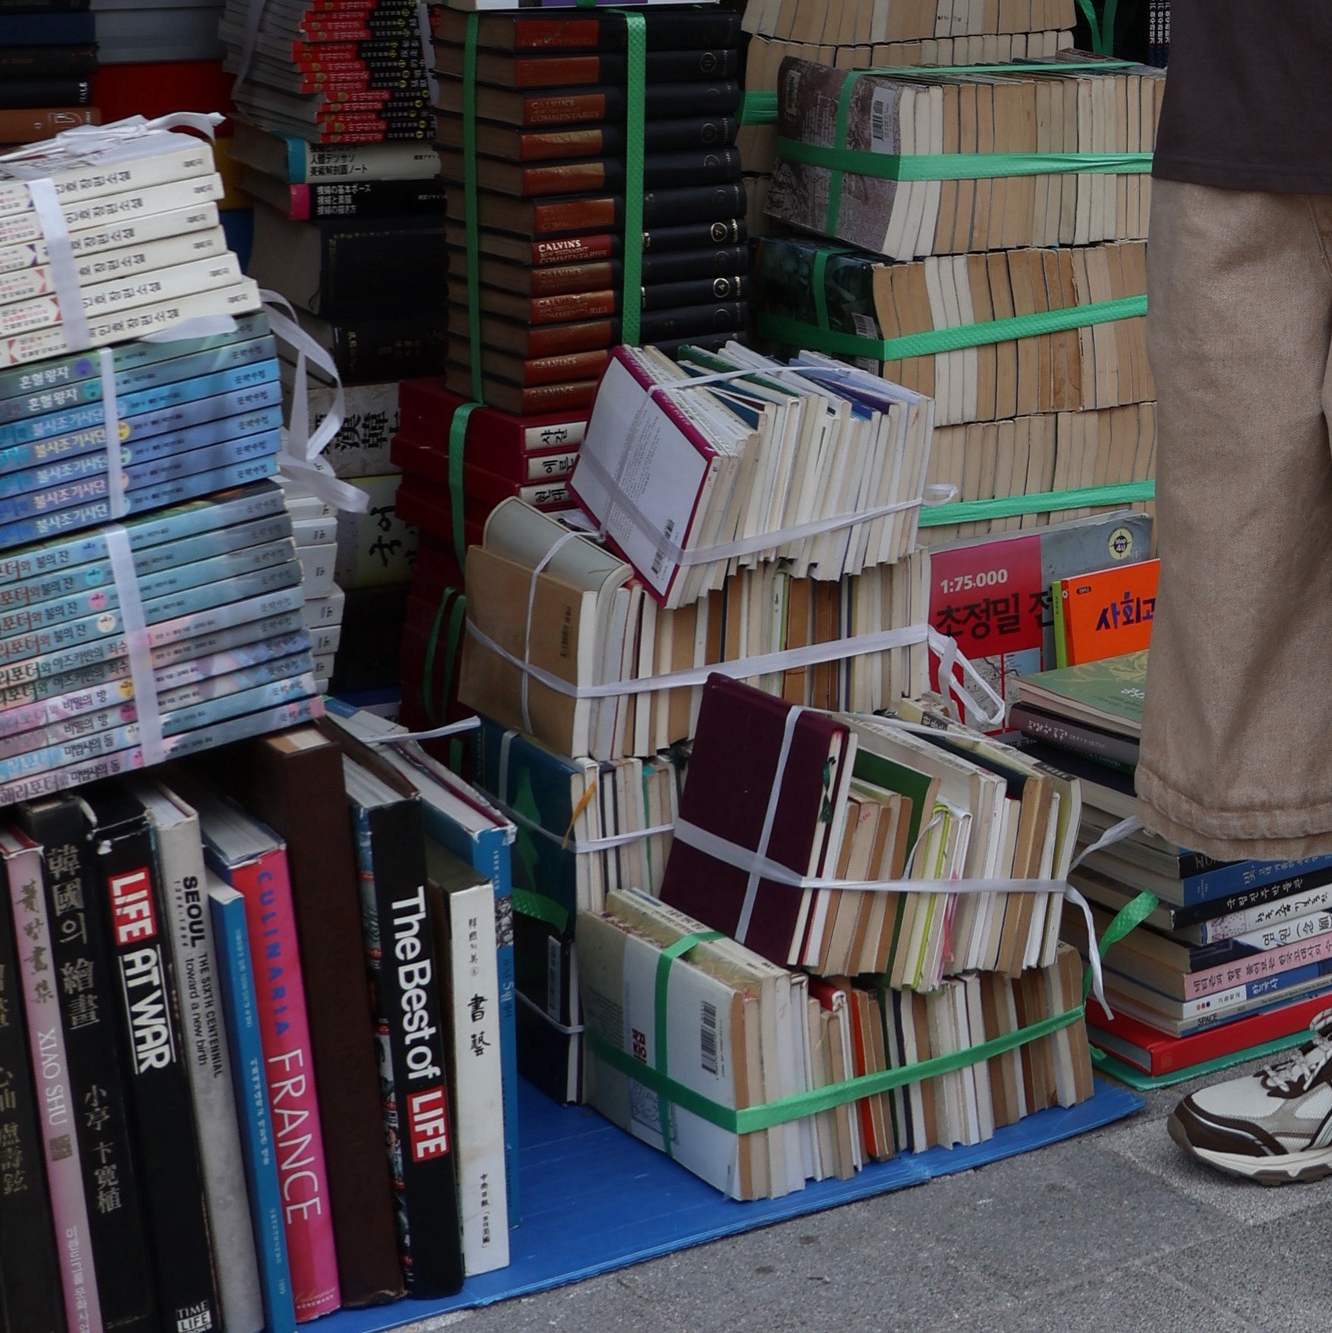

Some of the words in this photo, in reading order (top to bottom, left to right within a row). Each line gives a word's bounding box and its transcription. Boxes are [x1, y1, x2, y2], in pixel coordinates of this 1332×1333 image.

[538, 239, 582, 253] CALVIN'S
[940, 569, 1008, 594] 1:75,000
[936, 593, 1021, 640] 초정밀
[111, 871, 155, 943] LIFE
[183, 876, 205, 947] SEOUL
[391, 885, 427, 961] The
[123, 947, 161, 988] AT
[199, 953, 209, 974] THE
[256, 871, 291, 1037] CULINARIA
[185, 958, 200, 1000] toward
[196, 1038, 209, 1066] birth
[201, 977, 214, 1010] SIXTH
[397, 959, 438, 1045] Best
[130, 989, 171, 1074] WAR
[1197, 1012, 1218, 1027] SPACE
[38, 1027, 61, 1080] XIAO
[205, 1011, 223, 1079] CENTENNIAL
[405, 1044, 442, 1081] of
[45, 1085, 67, 1126] SHU
[410, 1090, 447, 1159] LIFE
[266, 1048, 322, 1224] FRANCE
[175, 1299, 209, 1319] TIME
[177, 1310, 212, 1331] LIFE
